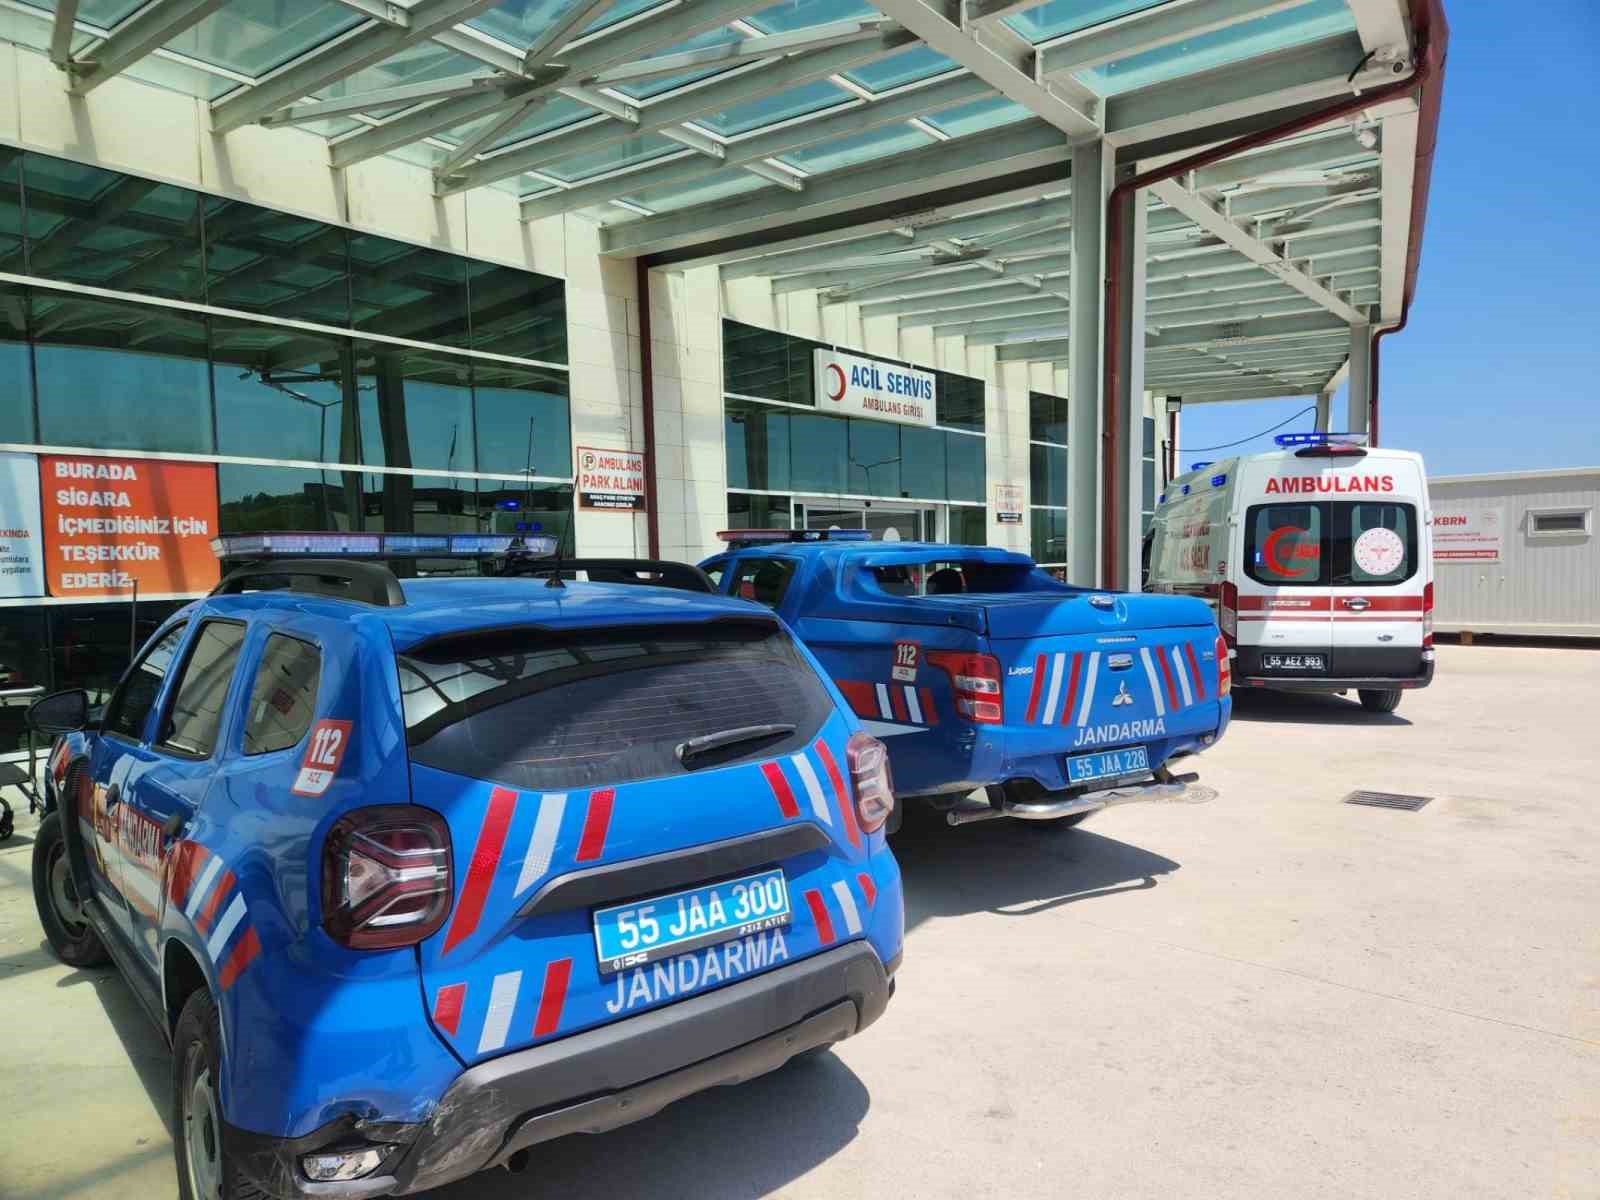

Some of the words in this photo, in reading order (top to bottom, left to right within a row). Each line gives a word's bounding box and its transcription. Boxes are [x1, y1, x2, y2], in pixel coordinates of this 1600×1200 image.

[851, 364, 883, 391] ACİL
[887, 372, 932, 400] SERVİS
[863, 396, 901, 415] AMBULANS
[55, 462, 137, 480] BURADA
[599, 457, 642, 472] AMBULANS
[583, 474, 610, 489] PARK
[613, 479, 643, 491] ALANI
[1265, 476, 1394, 494] AMBULANS
[56, 487, 131, 508] SİGARA
[58, 514, 169, 537] İÇMEDİĞİNİZ
[173, 516, 208, 538] İÇİN
[1434, 516, 1467, 526] KBRN
[60, 541, 160, 564] TEŞEKKÜR
[896, 644, 916, 665] 112
[1270, 656, 1280, 666] 55
[1285, 656, 1302, 666] AEZ
[1305, 656, 1321, 666] 993
[1074, 718, 1166, 746] JANDARMA
[310, 727, 342, 765] 112
[1076, 758, 1093, 778] 55
[1100, 754, 1122, 774] JAA
[1124, 749, 1147, 769] 228
[617, 906, 660, 948] 55
[669, 890, 726, 936] JAA
[732, 876, 783, 920] 300
[606, 928, 789, 1013] JANDARMA
